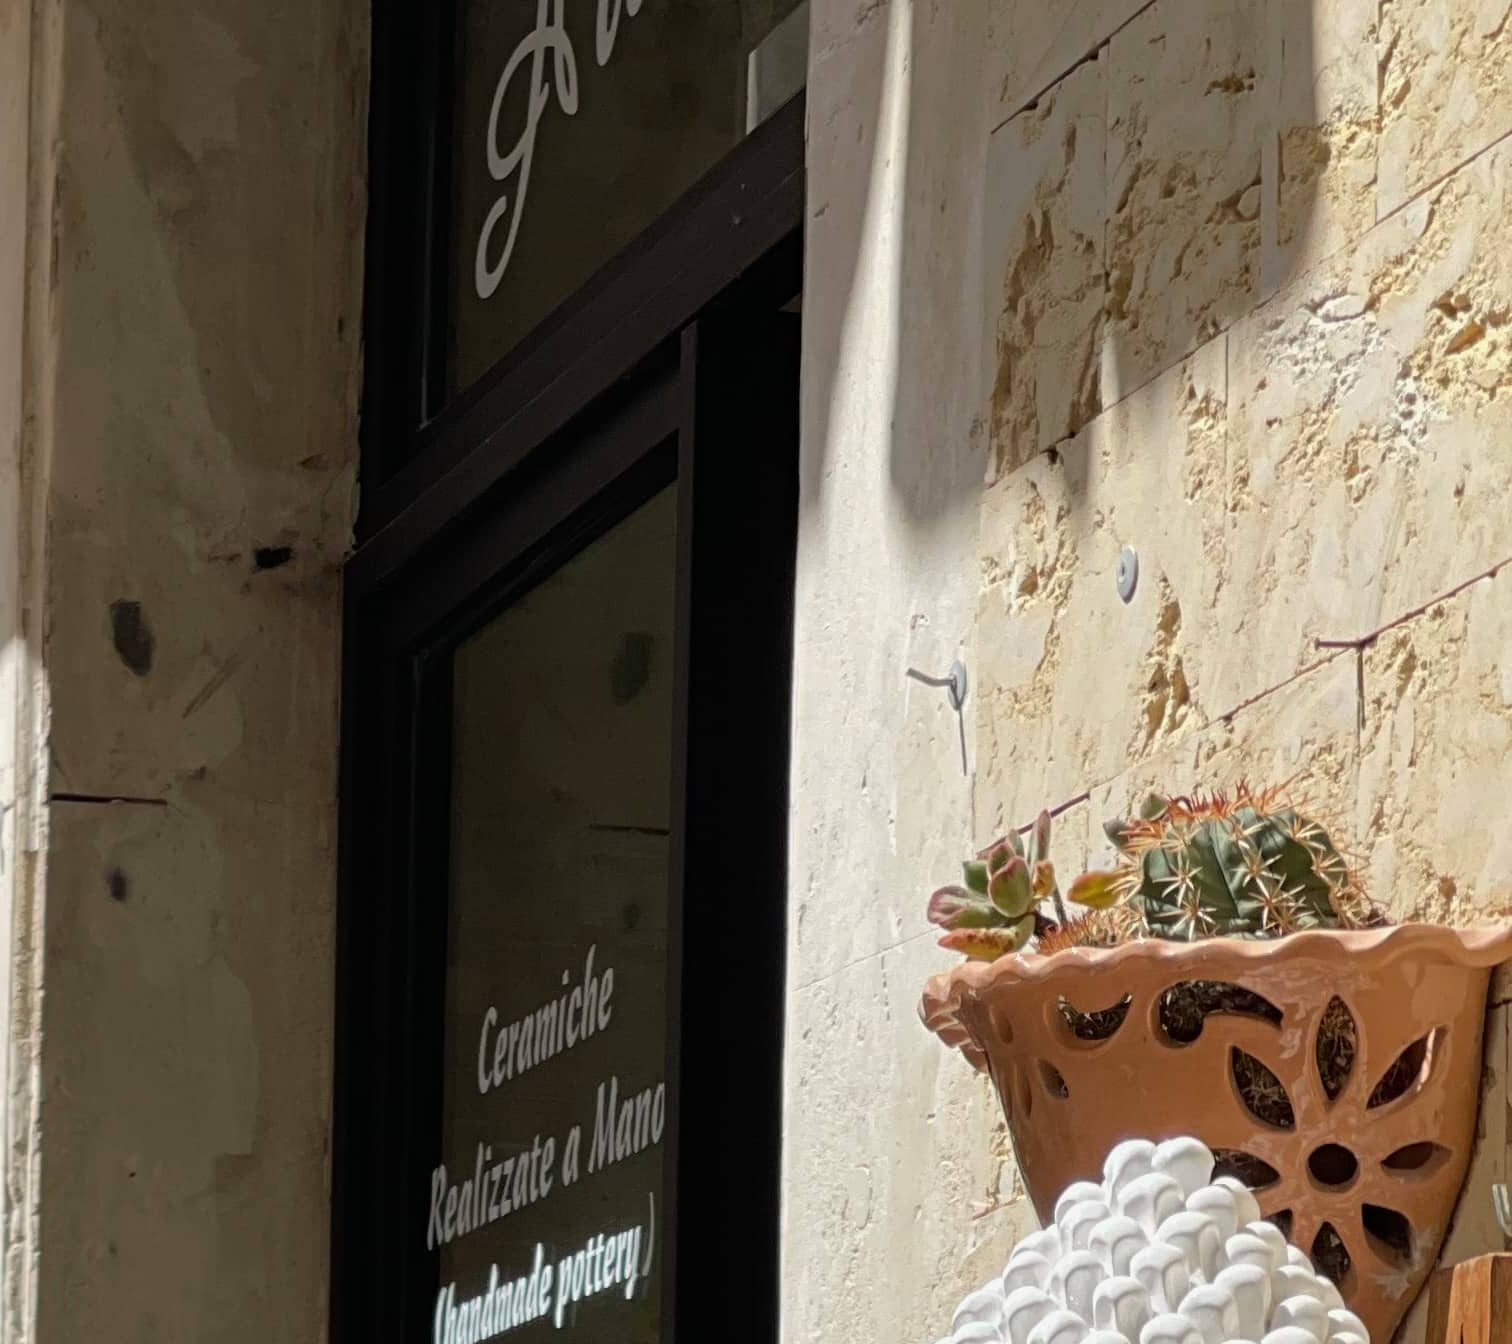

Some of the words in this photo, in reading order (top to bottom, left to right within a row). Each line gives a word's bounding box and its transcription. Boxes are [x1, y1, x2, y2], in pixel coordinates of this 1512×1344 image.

[478, 944, 613, 1094] Ceramiche
[427, 1142, 554, 1250] Realizzate
[562, 1126, 580, 1186] a
[588, 1076, 665, 1174] Mano
